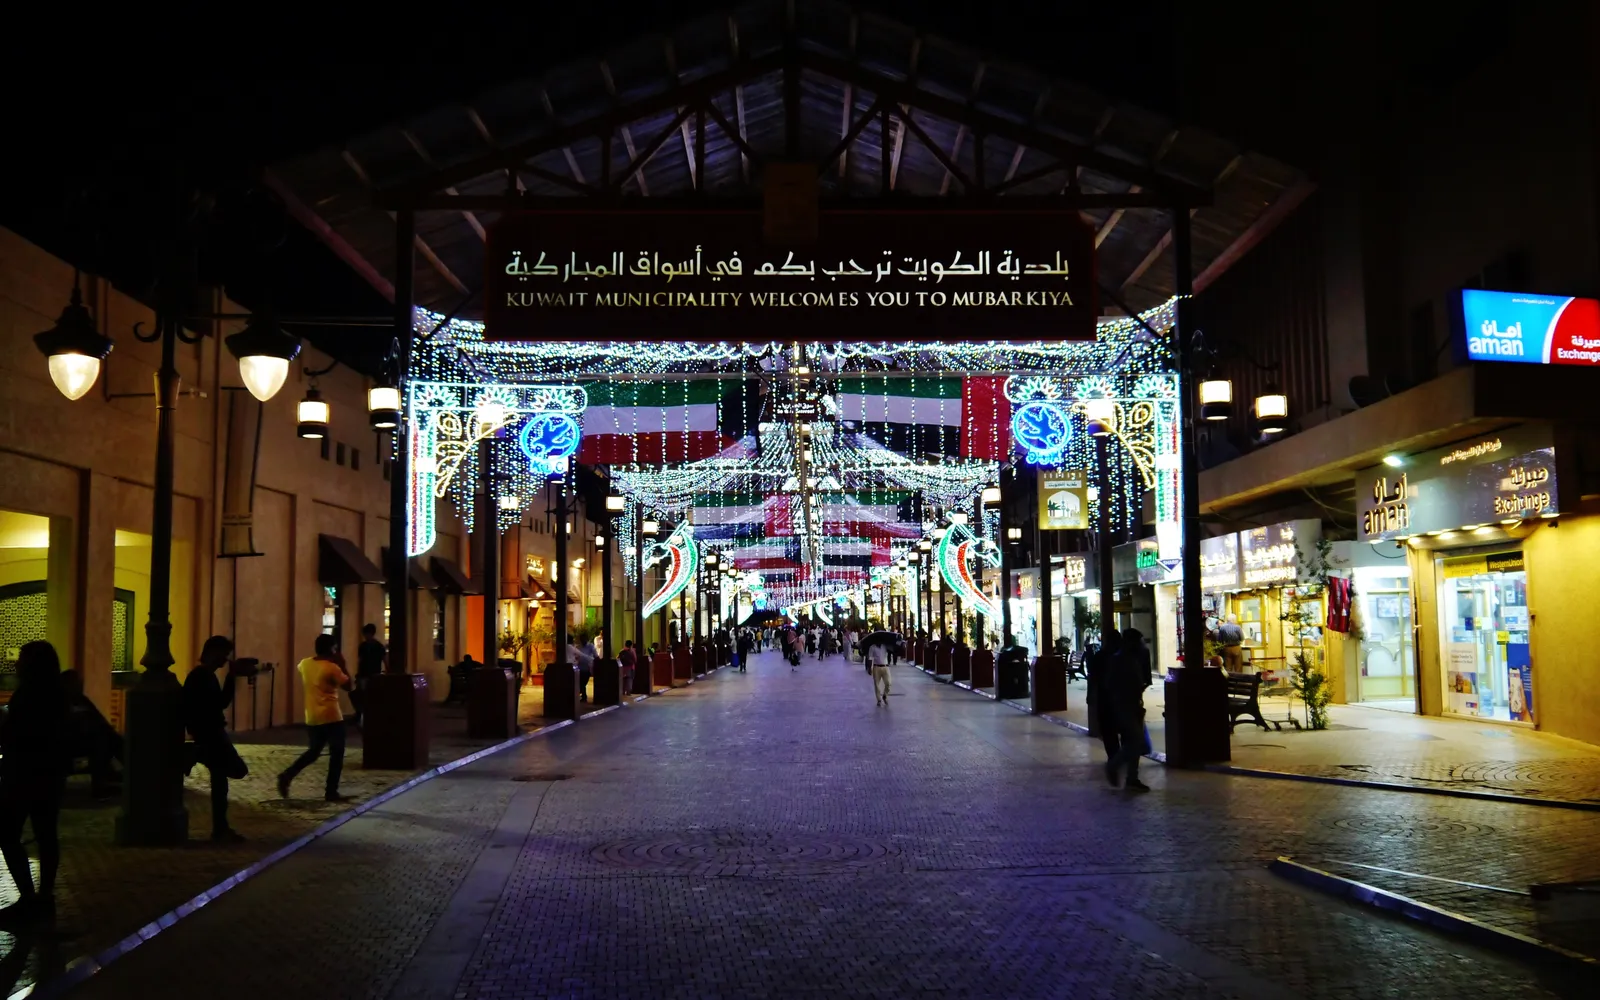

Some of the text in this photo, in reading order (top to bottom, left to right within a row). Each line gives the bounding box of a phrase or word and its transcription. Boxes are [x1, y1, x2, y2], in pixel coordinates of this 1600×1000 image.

[505, 245, 1069, 284] بلدية الكويت ترحب بكم في أسواق المباركية
[506, 292, 1073, 307] KUWAIT MUNICIPALITY WELCOMES YOU TO MUBARKIYA
[1470, 337, 1524, 355] aman
[1494, 491, 1550, 515] Exchange
[1363, 503, 1409, 535] aman
